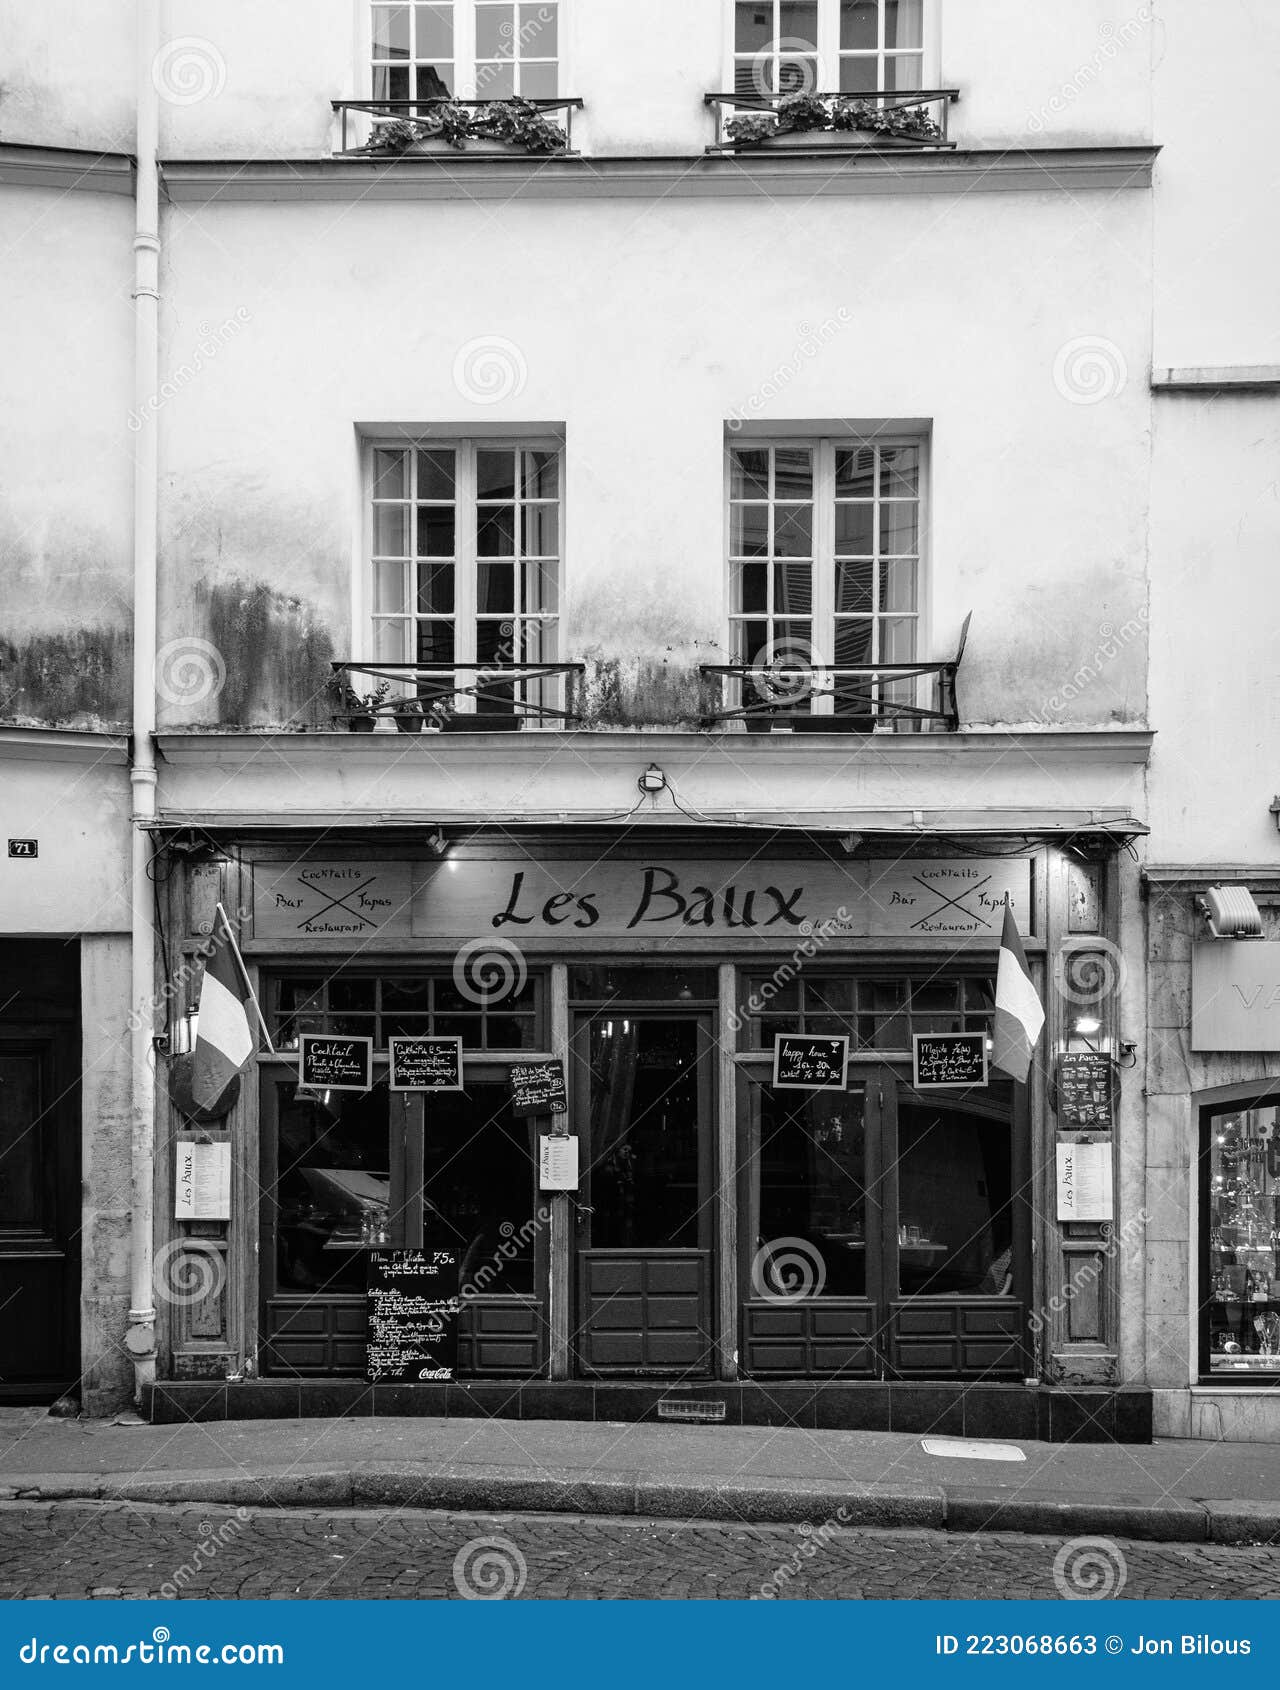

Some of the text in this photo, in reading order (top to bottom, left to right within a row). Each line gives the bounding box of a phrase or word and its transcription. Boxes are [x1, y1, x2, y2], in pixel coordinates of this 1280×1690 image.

[15, 843, 30, 854] 71
[302, 869, 361, 879] Cocktails
[921, 868, 980, 879] Cocktails
[276, 892, 391, 910] Bar Tapas
[492, 866, 806, 929] Les Baux
[890, 891, 917, 905] Bar
[305, 921, 365, 932] Restaurant
[920, 920, 981, 931] Restaurant
[311, 1043, 354, 1056] Cocktail
[783, 1042, 803, 1062] happy
[1079, 1053, 1099, 1062] Baux
[182, 1156, 192, 1206] Les Baux
[1062, 1156, 1073, 1207] Les Baux
